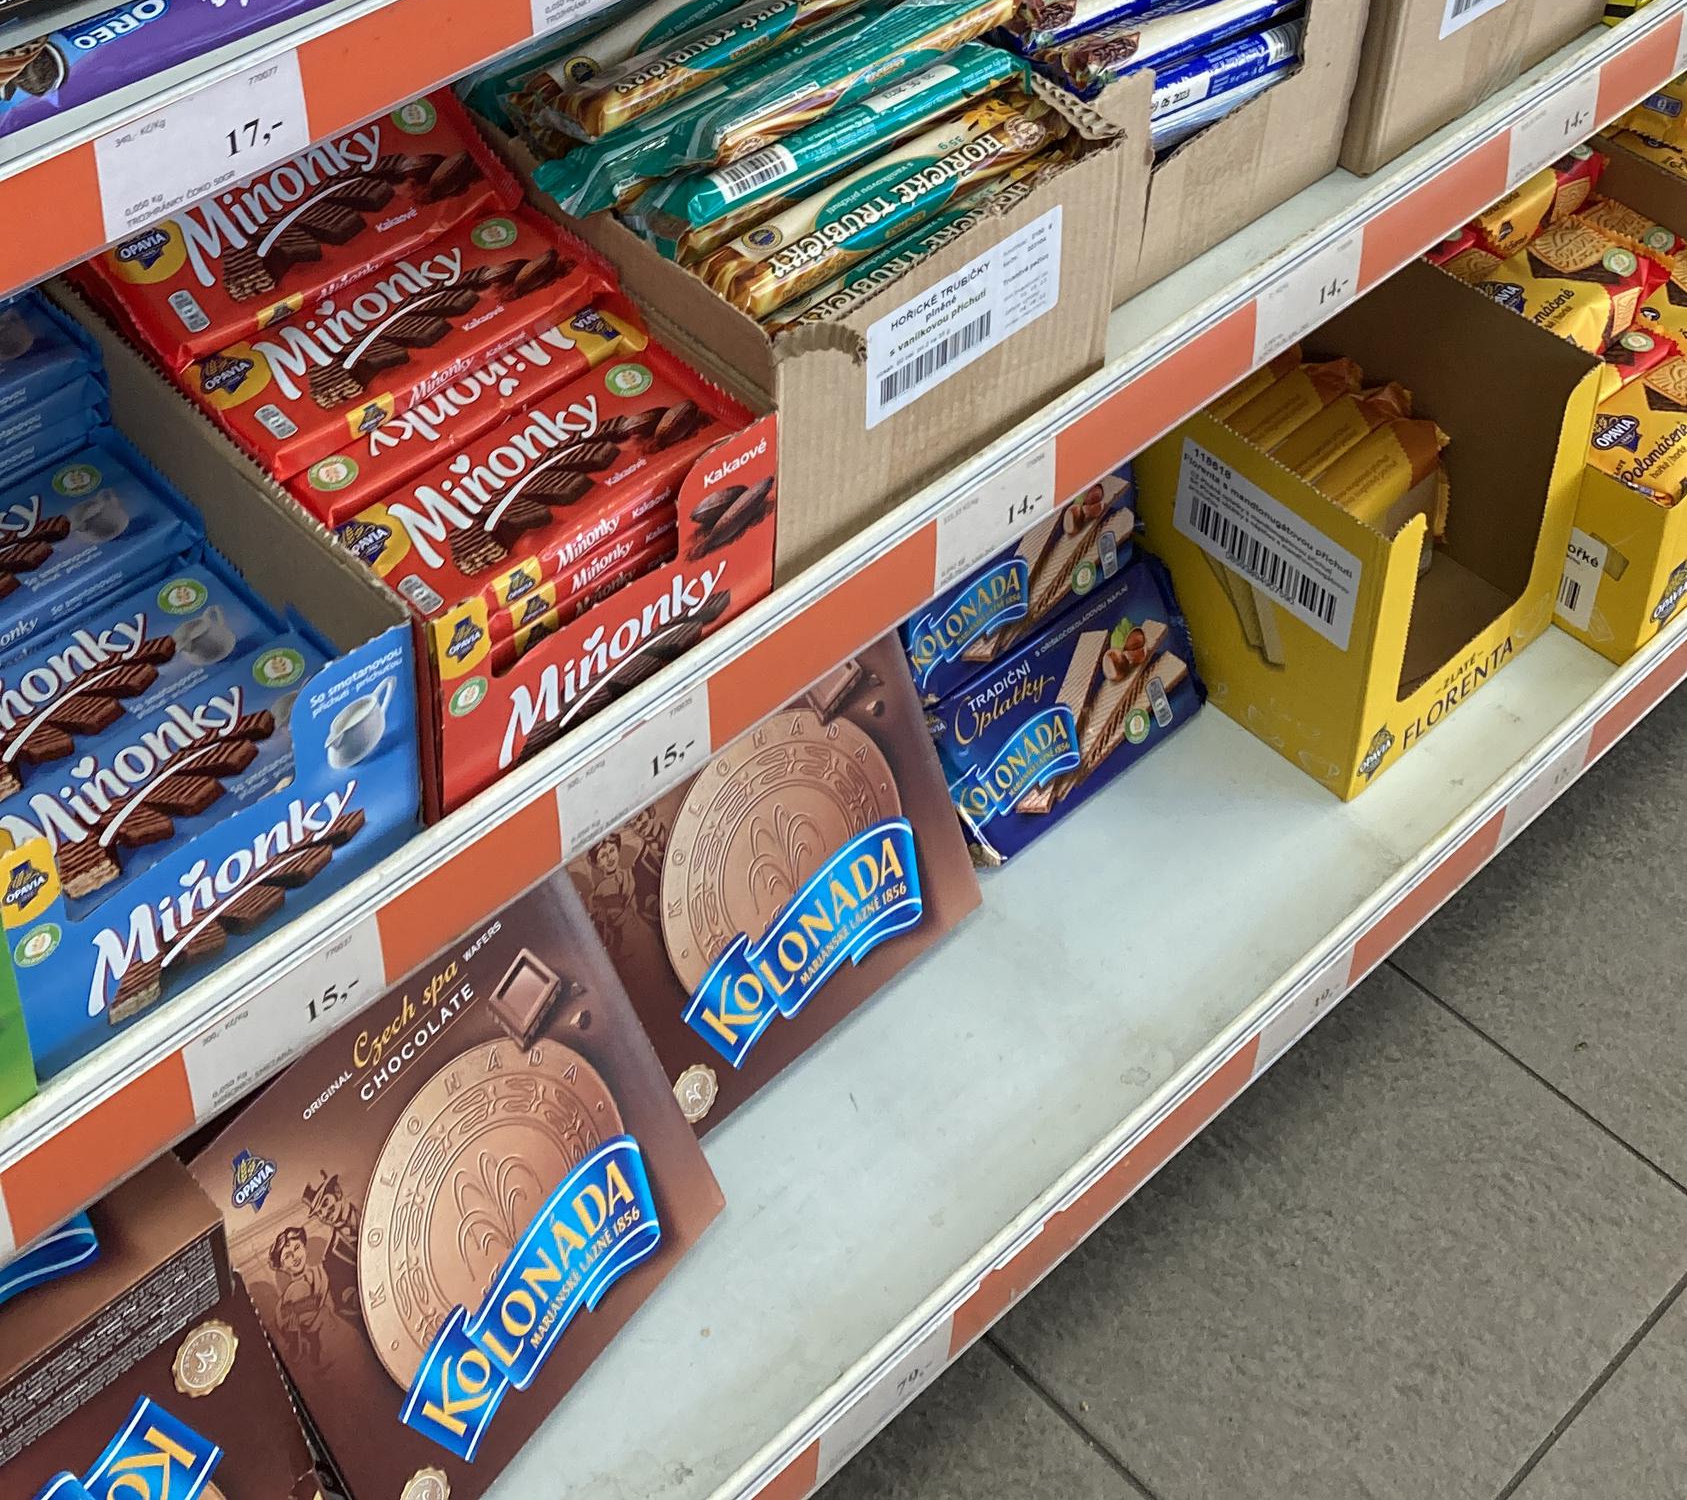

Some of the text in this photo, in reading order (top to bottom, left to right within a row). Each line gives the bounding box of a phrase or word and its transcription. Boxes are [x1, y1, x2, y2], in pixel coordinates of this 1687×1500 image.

[225, 118, 283, 159] 17,-
[1563, 110, 1590, 135] 14,-
[119, 229, 168, 265] OPAVIA
[940, 260, 991, 301] TRUBIČKY
[1319, 278, 1349, 307] 14,-
[1534, 288, 1575, 324] máčené
[203, 359, 254, 393] OPAVIA
[1596, 418, 1637, 449] OPAVIA
[702, 438, 768, 489] Kakaové
[1184, 452, 1220, 485] Florenta
[1007, 494, 1043, 525] 14,-
[1567, 543, 1599, 568] ořké
[446, 629, 484, 661] OPAVIA
[309, 693, 325, 709] So
[967, 658, 1031, 713] TRADIČNÍ
[1402, 636, 1514, 752] FLORENTA
[954, 674, 1056, 747] Oplatky
[651, 739, 695, 779] 15,-
[1357, 734, 1395, 775] OPAVIA
[6, 873, 49, 907] OPAVIA
[881, 880, 908, 907] 1856
[700, 837, 906, 1046] KOLONÁDA
[305, 979, 359, 1022] 15,-
[302, 1070, 353, 1120] ORIGINAL
[353, 994, 417, 1069] Czech
[422, 960, 459, 1007] spa
[462, 920, 502, 963] WAFERS
[360, 982, 475, 1101] CHOCOLATE
[235, 1161, 275, 1207] OPAVIA
[612, 1205, 642, 1238] 1856
[420, 1158, 635, 1437] KOLONÁDA
